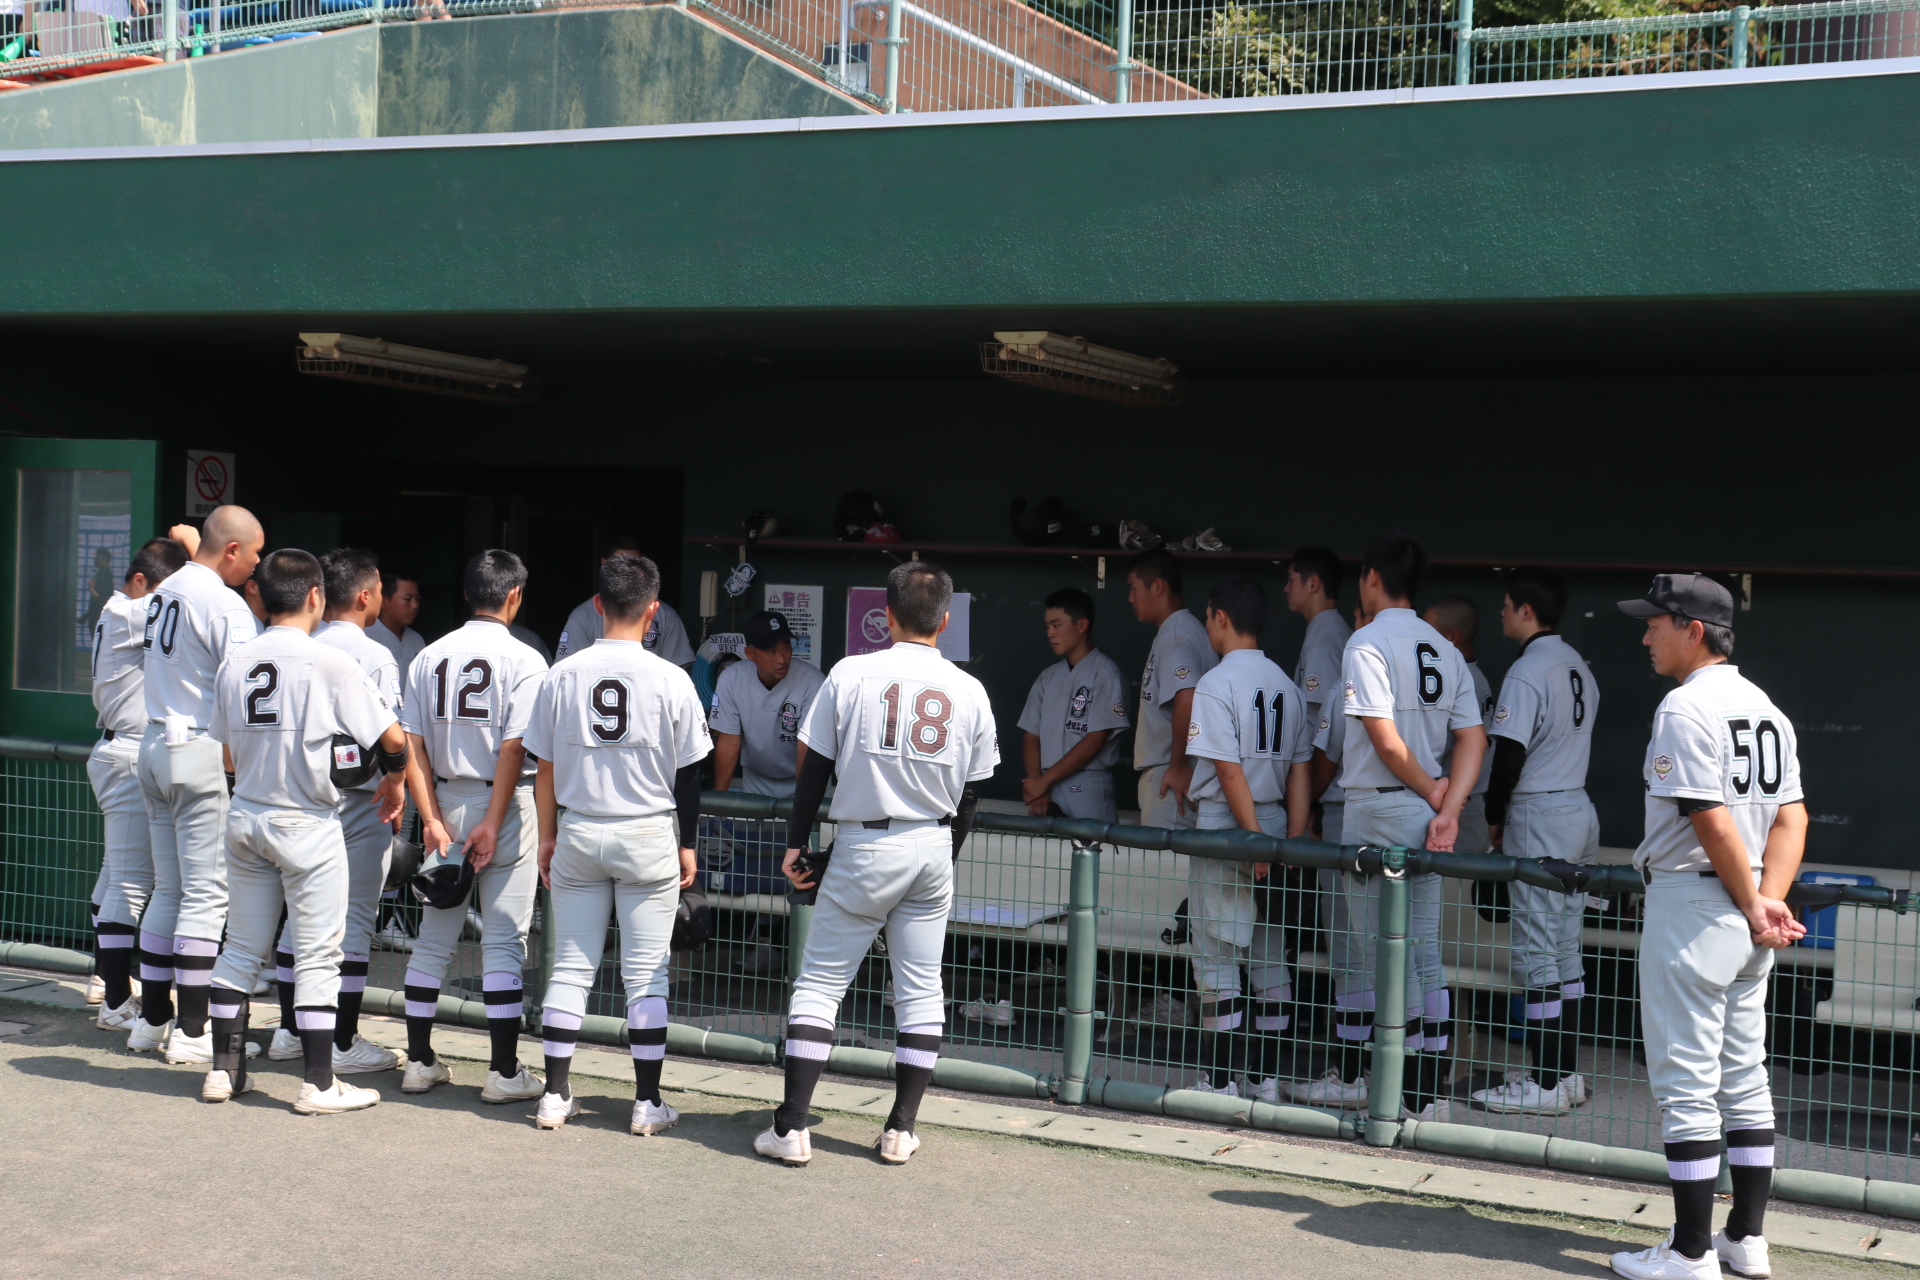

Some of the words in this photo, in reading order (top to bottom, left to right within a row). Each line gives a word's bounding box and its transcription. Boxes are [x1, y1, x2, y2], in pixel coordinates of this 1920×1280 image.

[143, 592, 180, 658] 20
[782, 591, 811, 608] 警告
[710, 635, 745, 644] SETAGAYA
[718, 644, 738, 653] WEST
[858, 646, 880, 654] ゴミは
[245, 660, 281, 727] 2
[432, 655, 495, 722] 12
[1414, 640, 1445, 706] 6
[1569, 666, 1585, 730] 8
[589, 676, 631, 743] 9
[880, 680, 955, 758] 18
[1252, 687, 1286, 755] 11
[1723, 715, 1784, 798] 50
